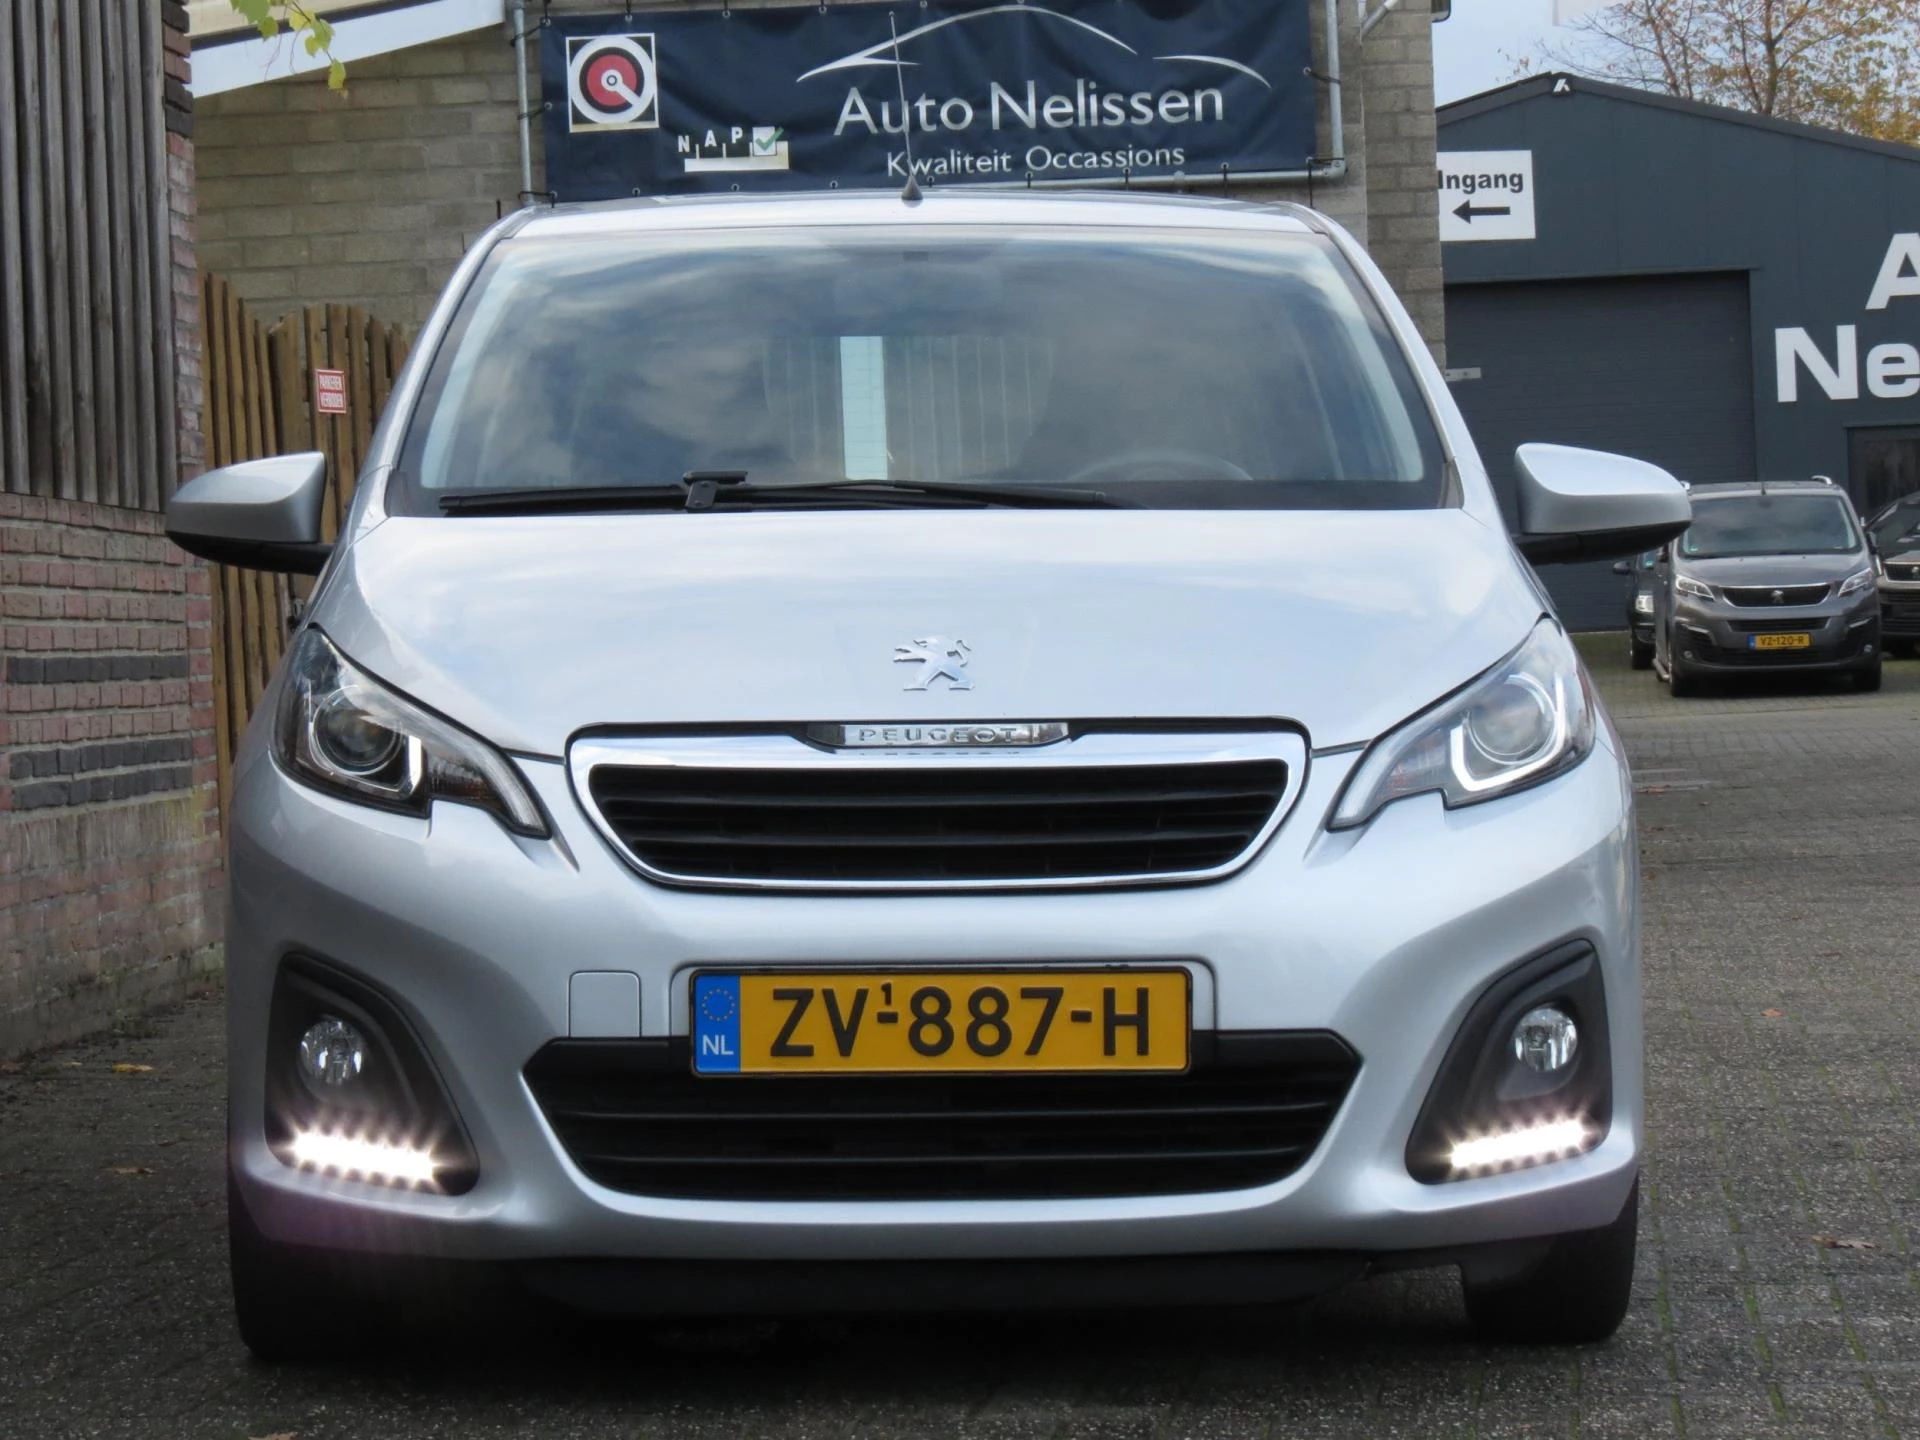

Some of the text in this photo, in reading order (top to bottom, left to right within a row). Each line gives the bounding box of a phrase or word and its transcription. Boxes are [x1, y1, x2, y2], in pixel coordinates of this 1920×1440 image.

[833, 78, 1224, 136] Auto Nelissen
[887, 144, 1186, 177] Kwaliteit Occassions
[1437, 169, 1524, 195] Ingang
[858, 727, 1017, 744] PEUGEOT
[702, 1034, 734, 1056] NL
